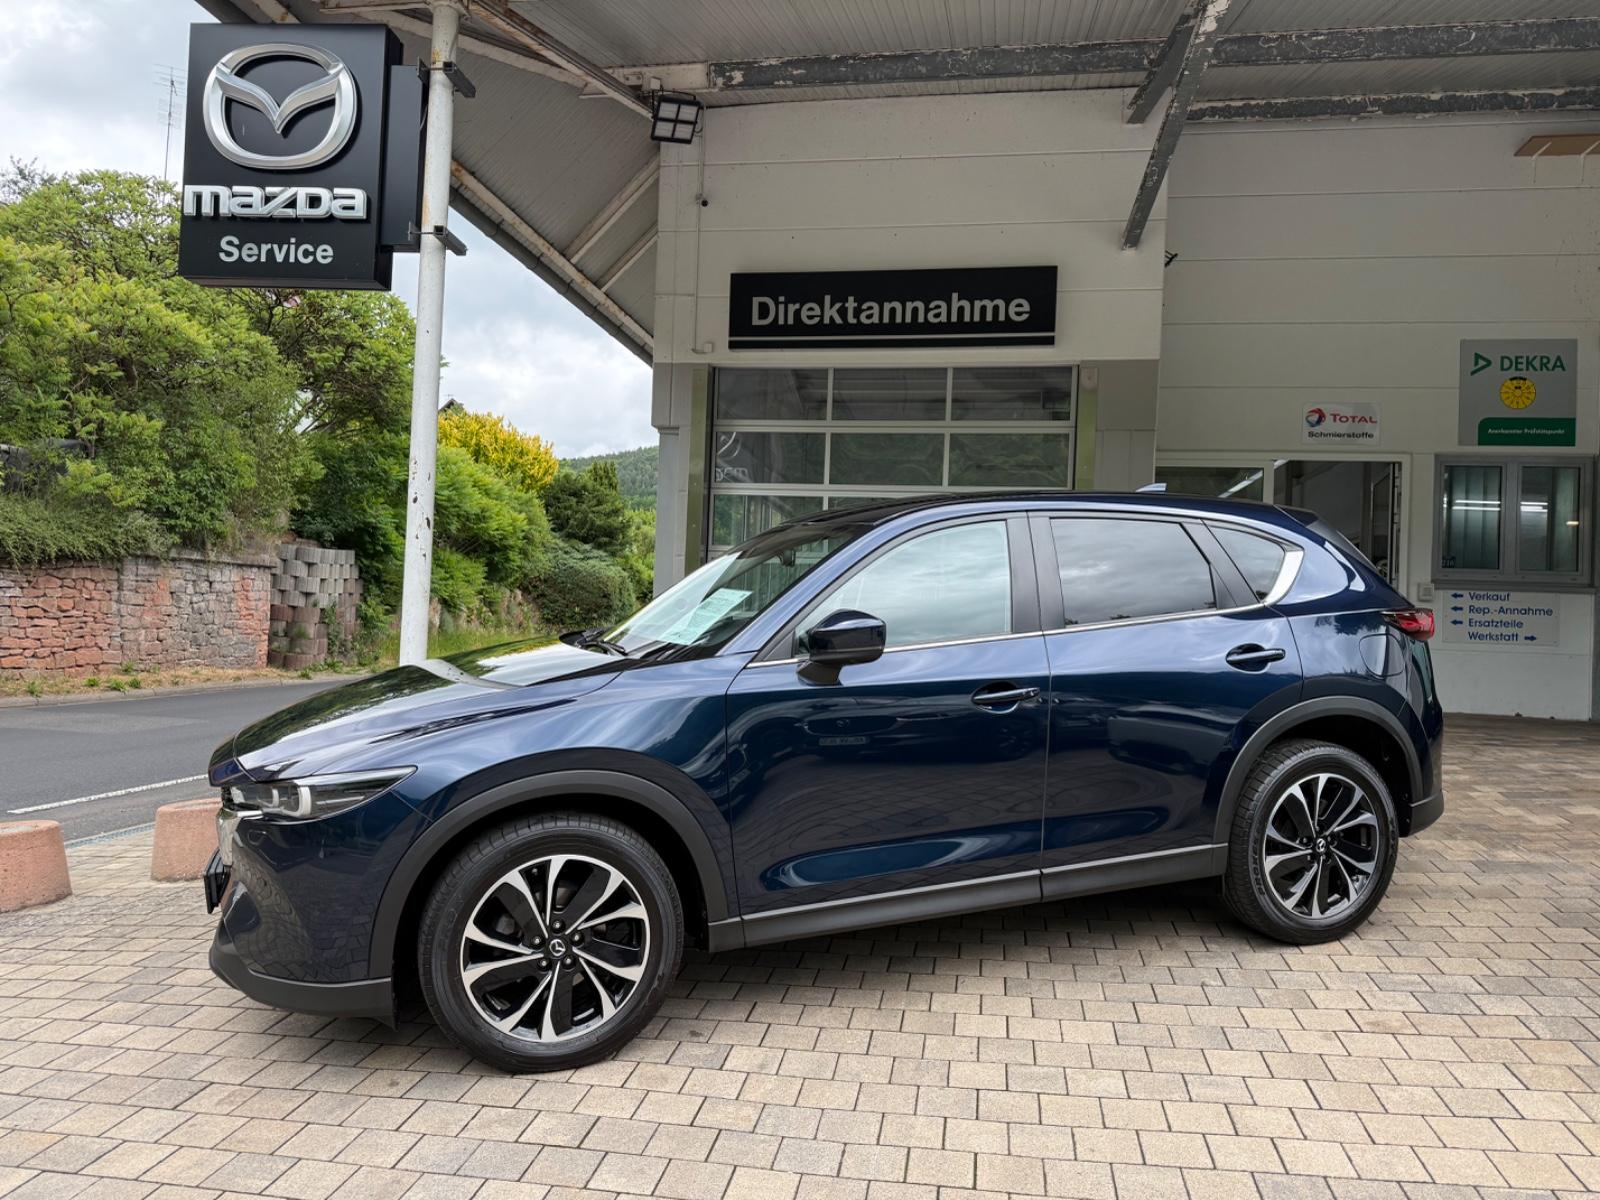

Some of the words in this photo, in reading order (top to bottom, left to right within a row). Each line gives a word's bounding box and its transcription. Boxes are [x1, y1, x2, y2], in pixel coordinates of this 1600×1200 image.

[184, 185, 367, 220] mazda
[219, 235, 334, 264] Service
[751, 292, 1031, 326] Direktannahme
[1500, 355, 1566, 372] DEKRA
[1329, 413, 1378, 424] TOTAL
[1307, 431, 1374, 439] Schmierstoffe
[1468, 591, 1511, 602] Verkauf
[1468, 605, 1554, 617] Rep.-Annahme
[1468, 618, 1524, 629] Ersatzteile
[1467, 631, 1519, 642] Werkstatt
